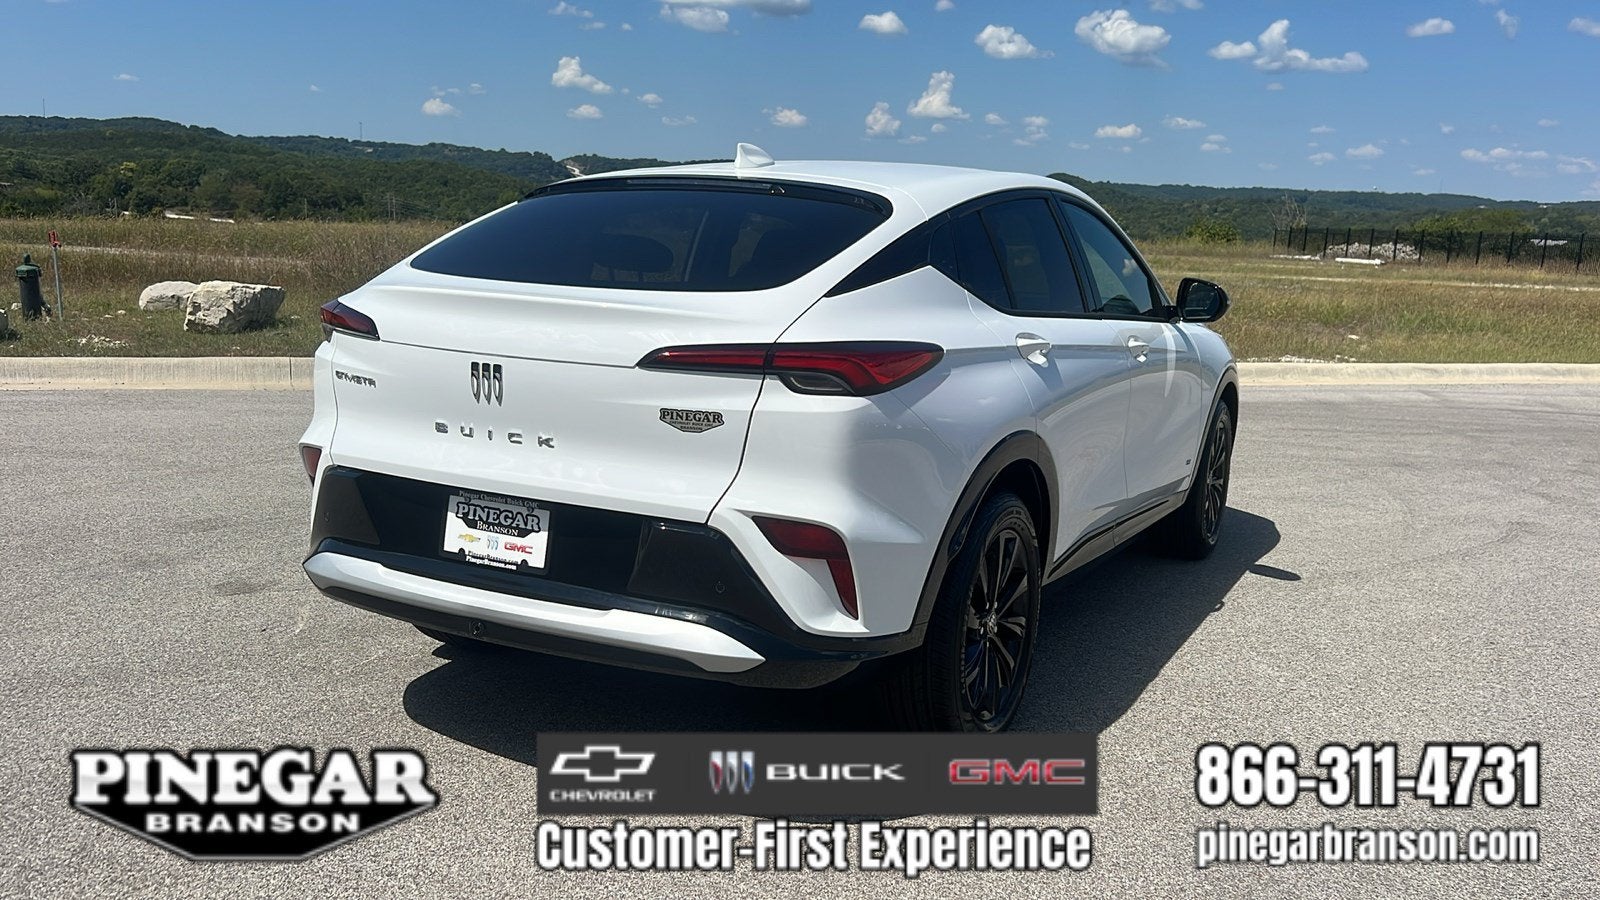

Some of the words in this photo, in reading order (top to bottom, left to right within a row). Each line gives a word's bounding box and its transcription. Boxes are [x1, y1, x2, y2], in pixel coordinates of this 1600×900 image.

[661, 410, 722, 424] PINEGAR
[434, 421, 555, 449] BUICK
[524, 500, 540, 509] GMC
[456, 503, 540, 532] PINEGAR
[504, 542, 533, 555] GMC
